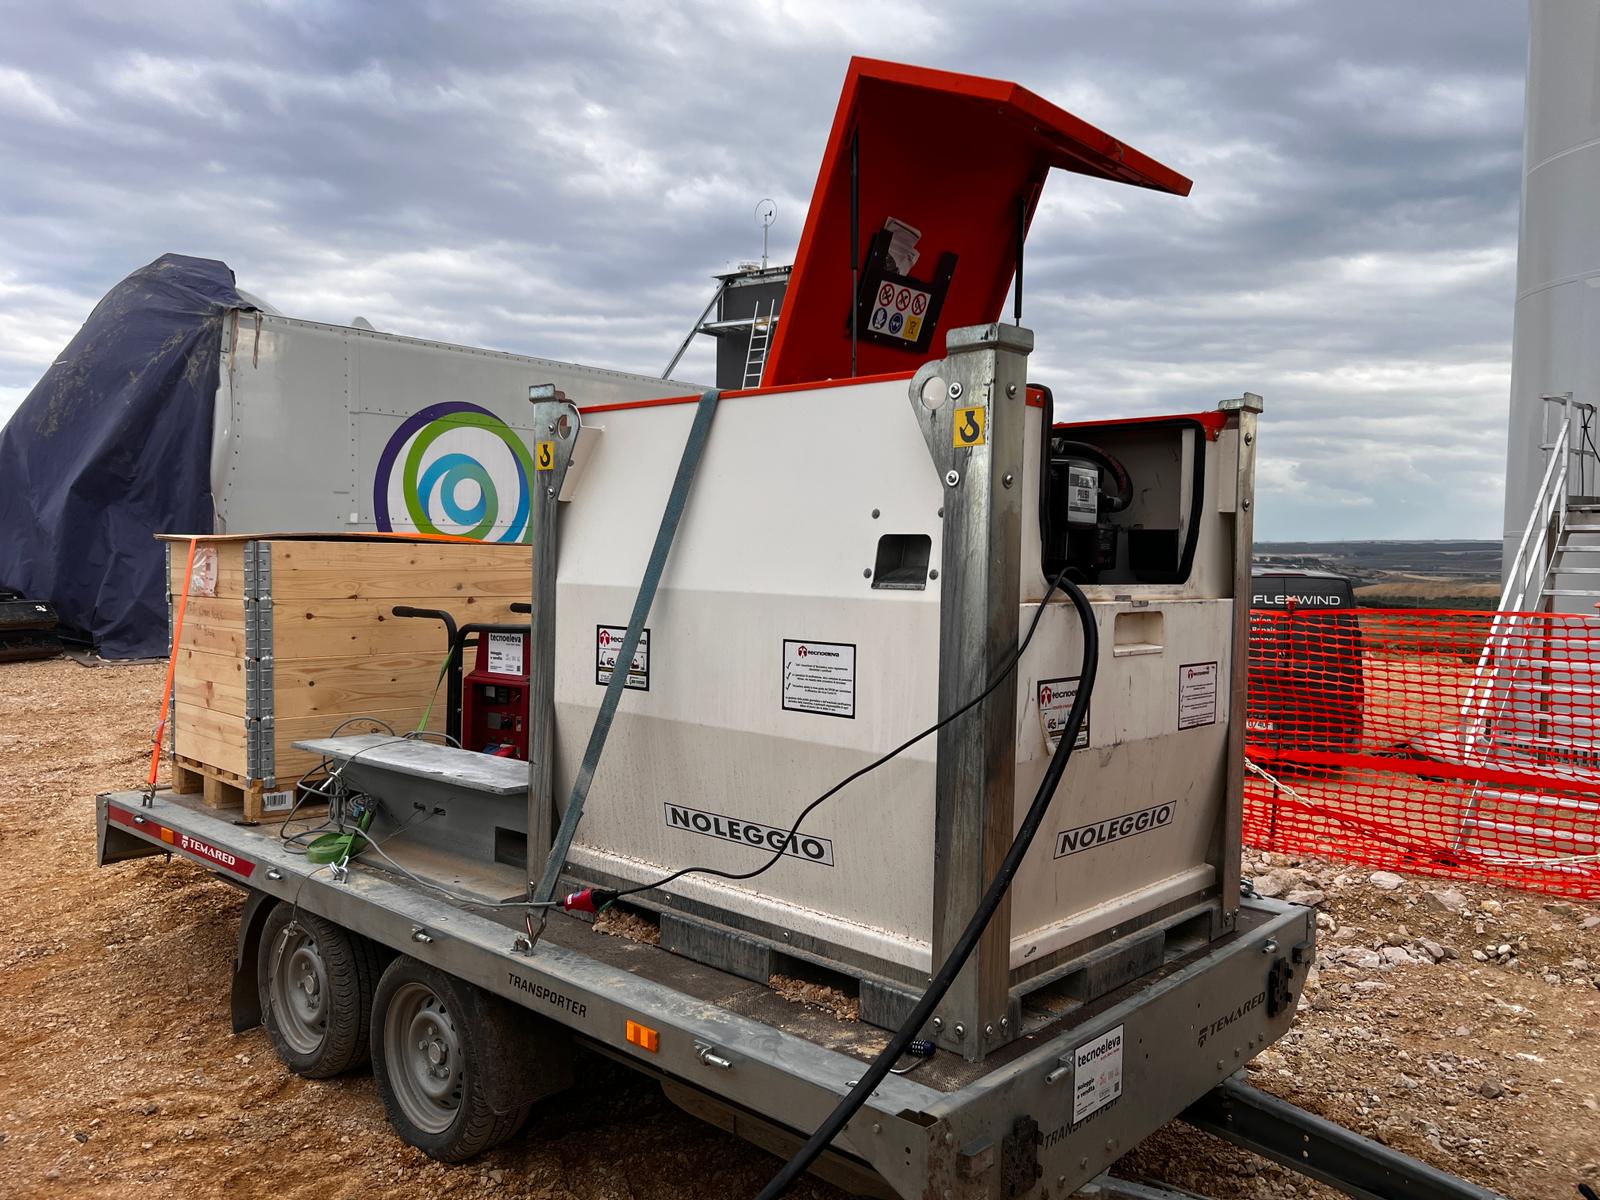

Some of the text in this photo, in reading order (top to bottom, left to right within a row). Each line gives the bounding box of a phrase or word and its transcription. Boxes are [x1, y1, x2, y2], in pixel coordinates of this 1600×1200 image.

[1253, 594, 1341, 606] FLEXWIND
[490, 633, 521, 643] tecnoeleva
[671, 807, 825, 859] NOLEGGIO
[1060, 806, 1170, 854] NOLEGGIO
[189, 839, 236, 866] TEMARED
[508, 972, 587, 1018] TRANSPORTER
[1210, 992, 1266, 1036] TEMARED
[1078, 1035, 1121, 1068] tecnoeleva
